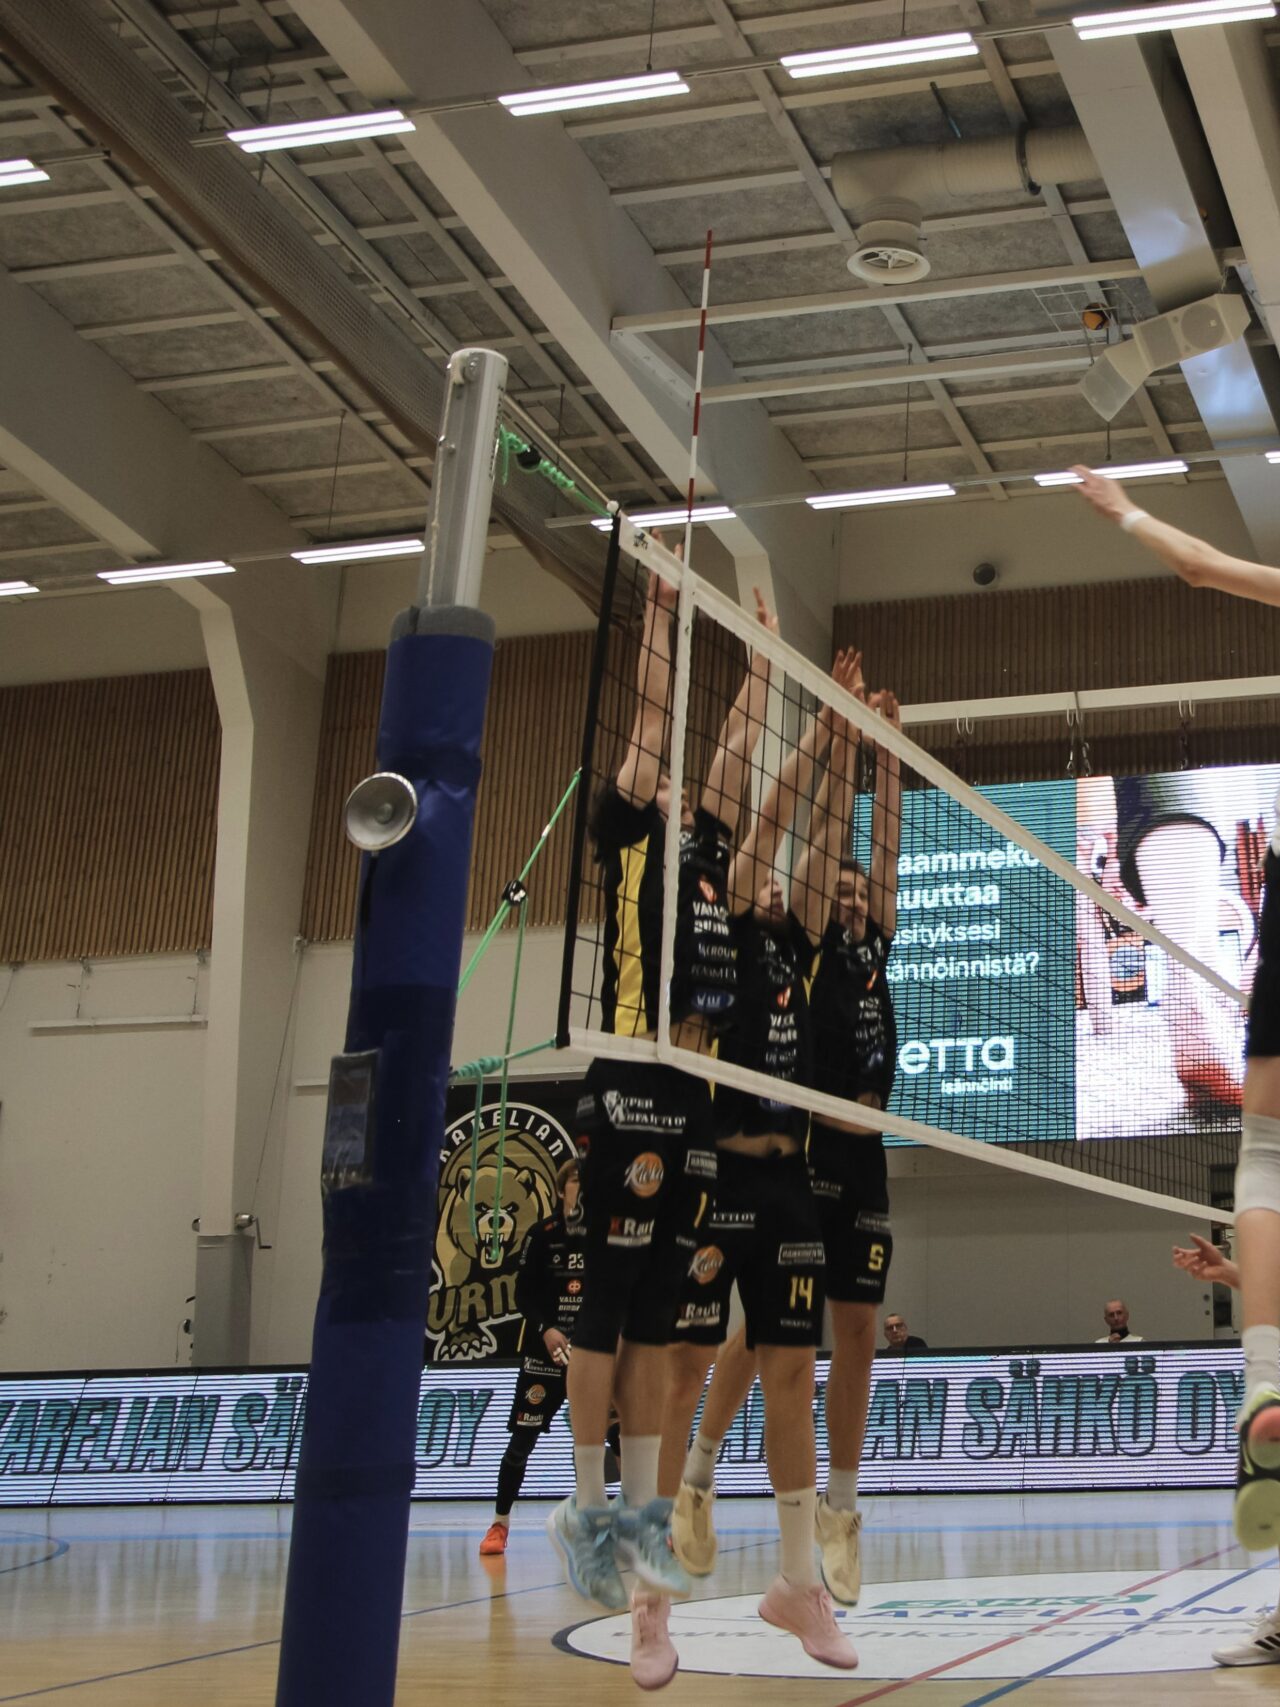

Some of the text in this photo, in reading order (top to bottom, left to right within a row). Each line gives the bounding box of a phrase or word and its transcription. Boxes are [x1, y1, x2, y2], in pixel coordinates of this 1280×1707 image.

[789, 1277, 813, 1310] 14
[0, 1398, 222, 1476] ARELIAN
[963, 1356, 1159, 1460] SÄHKÖ
